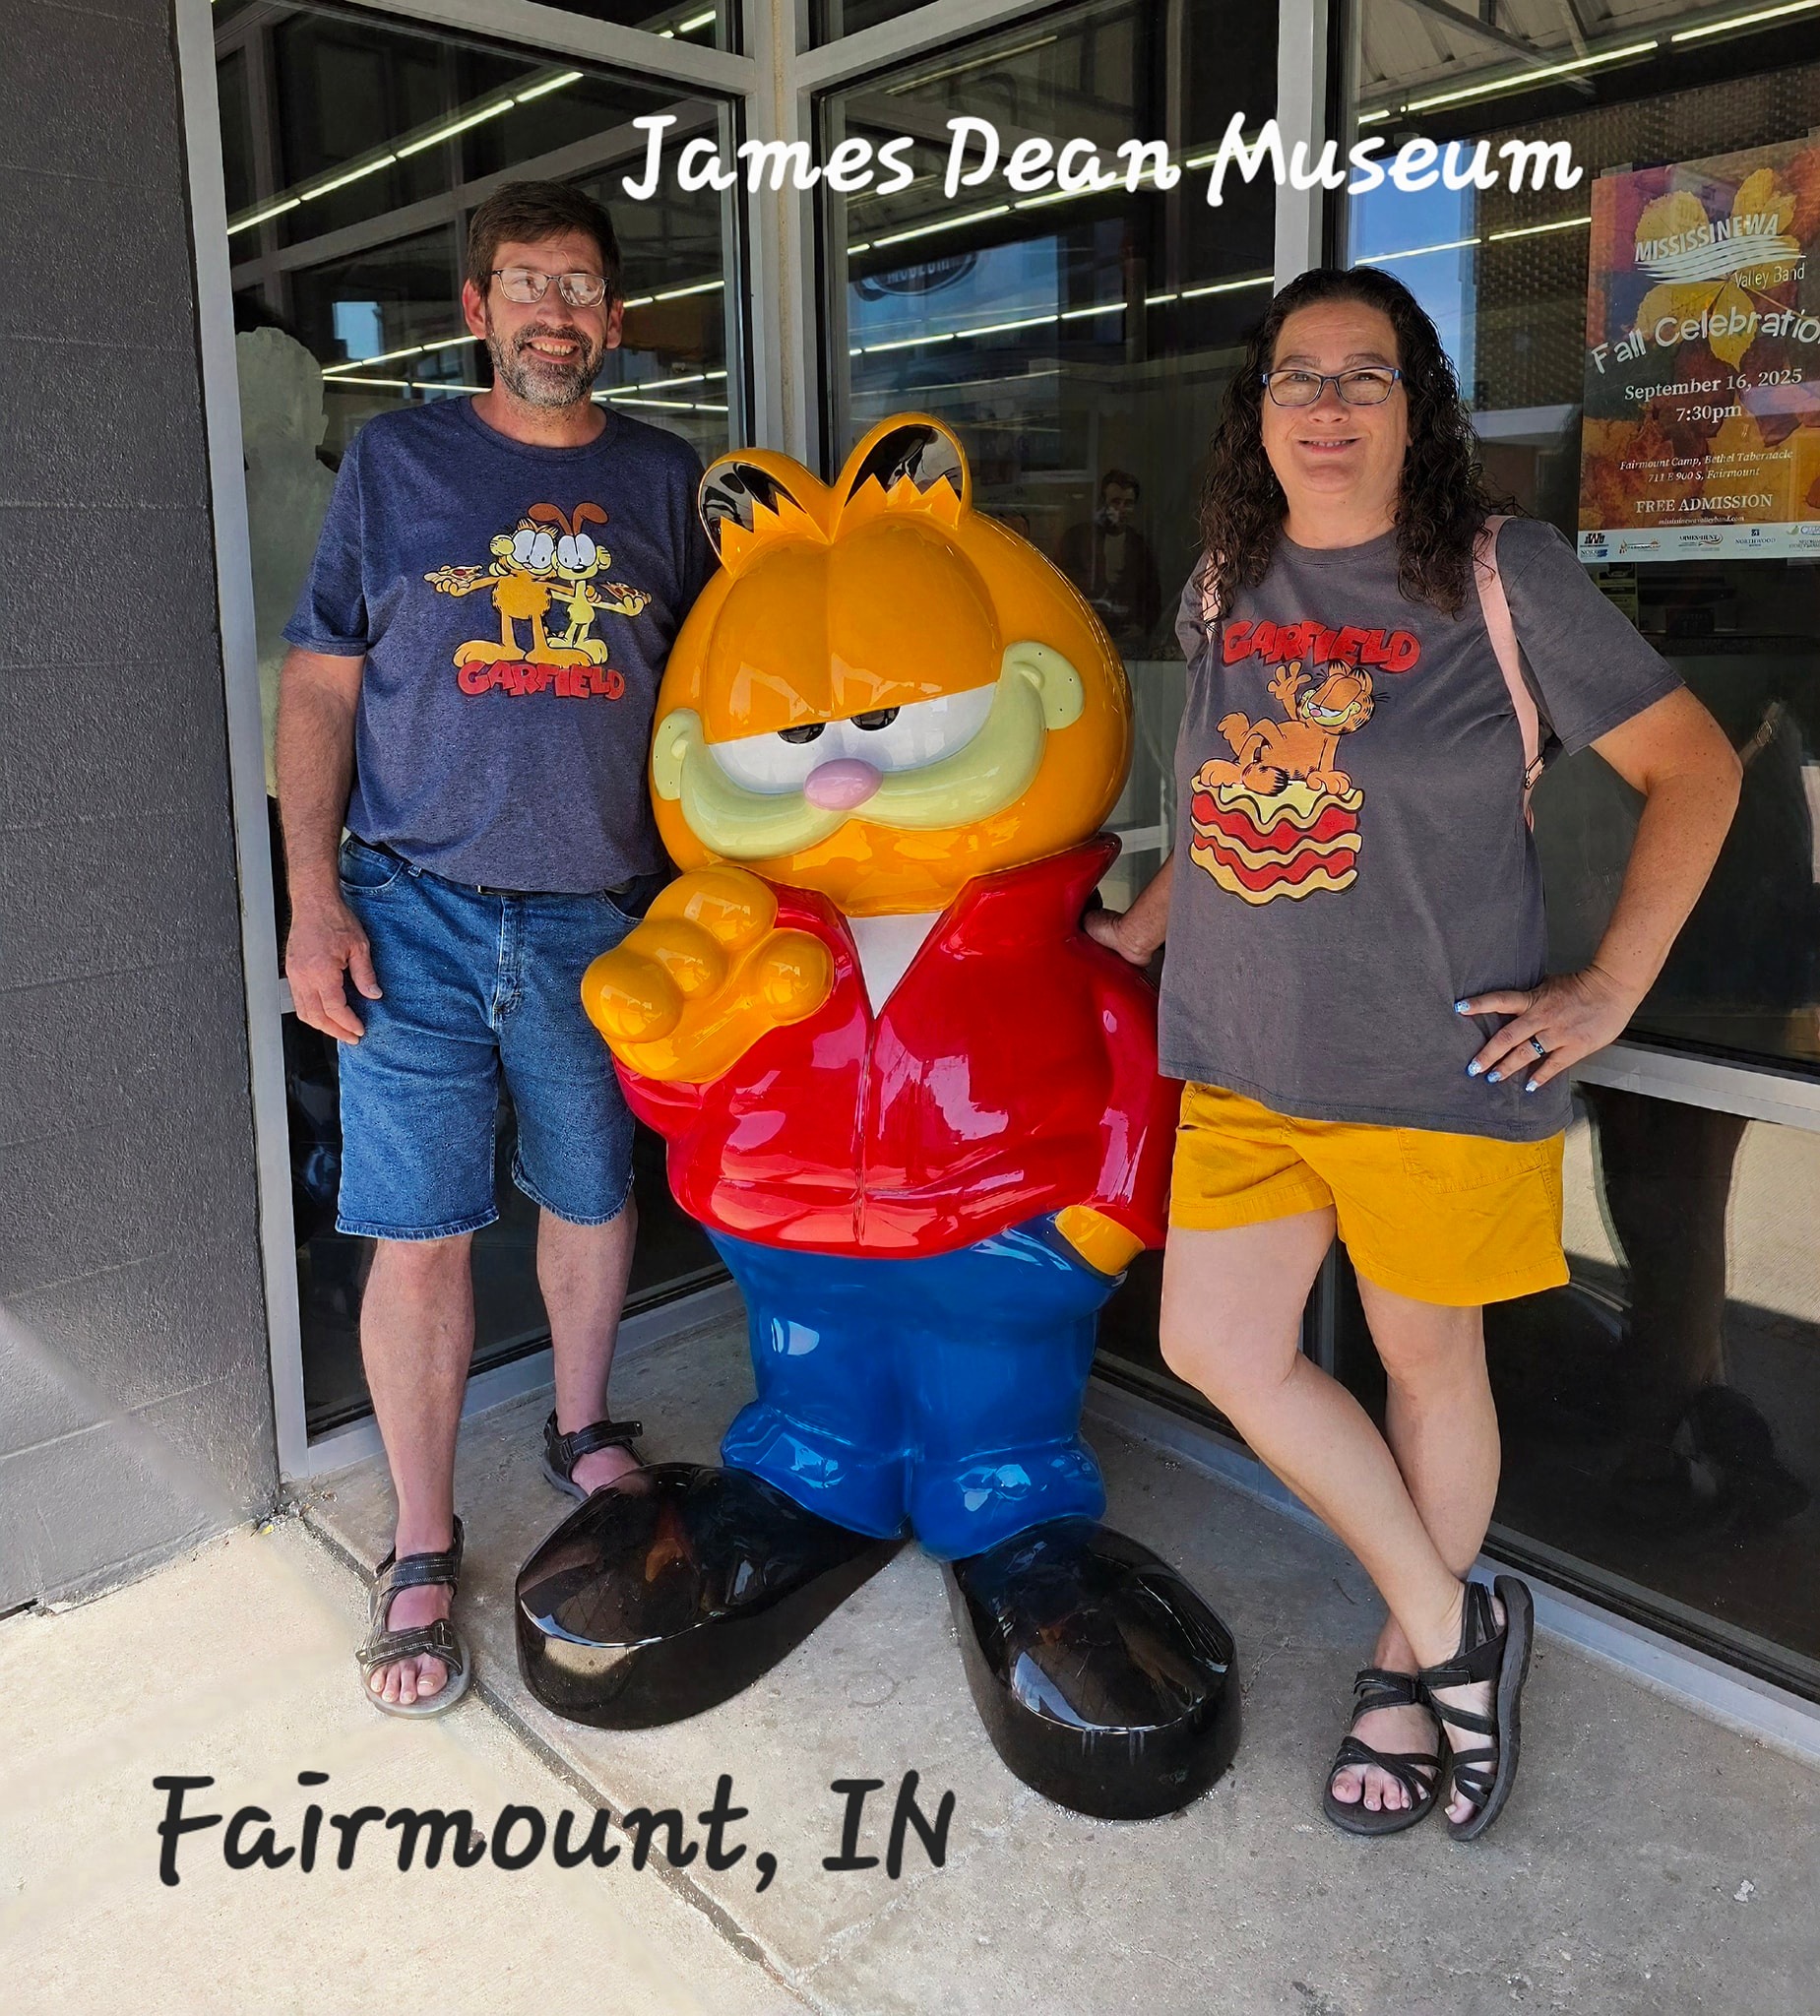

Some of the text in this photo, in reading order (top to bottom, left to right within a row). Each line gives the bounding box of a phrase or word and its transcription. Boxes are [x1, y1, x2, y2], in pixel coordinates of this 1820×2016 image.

[1635, 213, 1780, 262] MISSISSINEWA
[1734, 263, 1805, 288] Valley Band
[1591, 306, 1820, 374] Fall Celebratio
[1624, 368, 1802, 402] September 16, 2025
[1676, 405, 1742, 424] 7:30pm
[1619, 449, 1793, 471] Fairmount Camp, Bethel Tabernacle
[1648, 473, 1664, 483] 711
[1667, 472, 1674, 481] E
[1707, 468, 1760, 479] Fairmount
[1636, 494, 1773, 514] FREE ADMISSION
[1223, 619, 1421, 673] GARFIELD
[457, 660, 625, 700] GARFIELD
